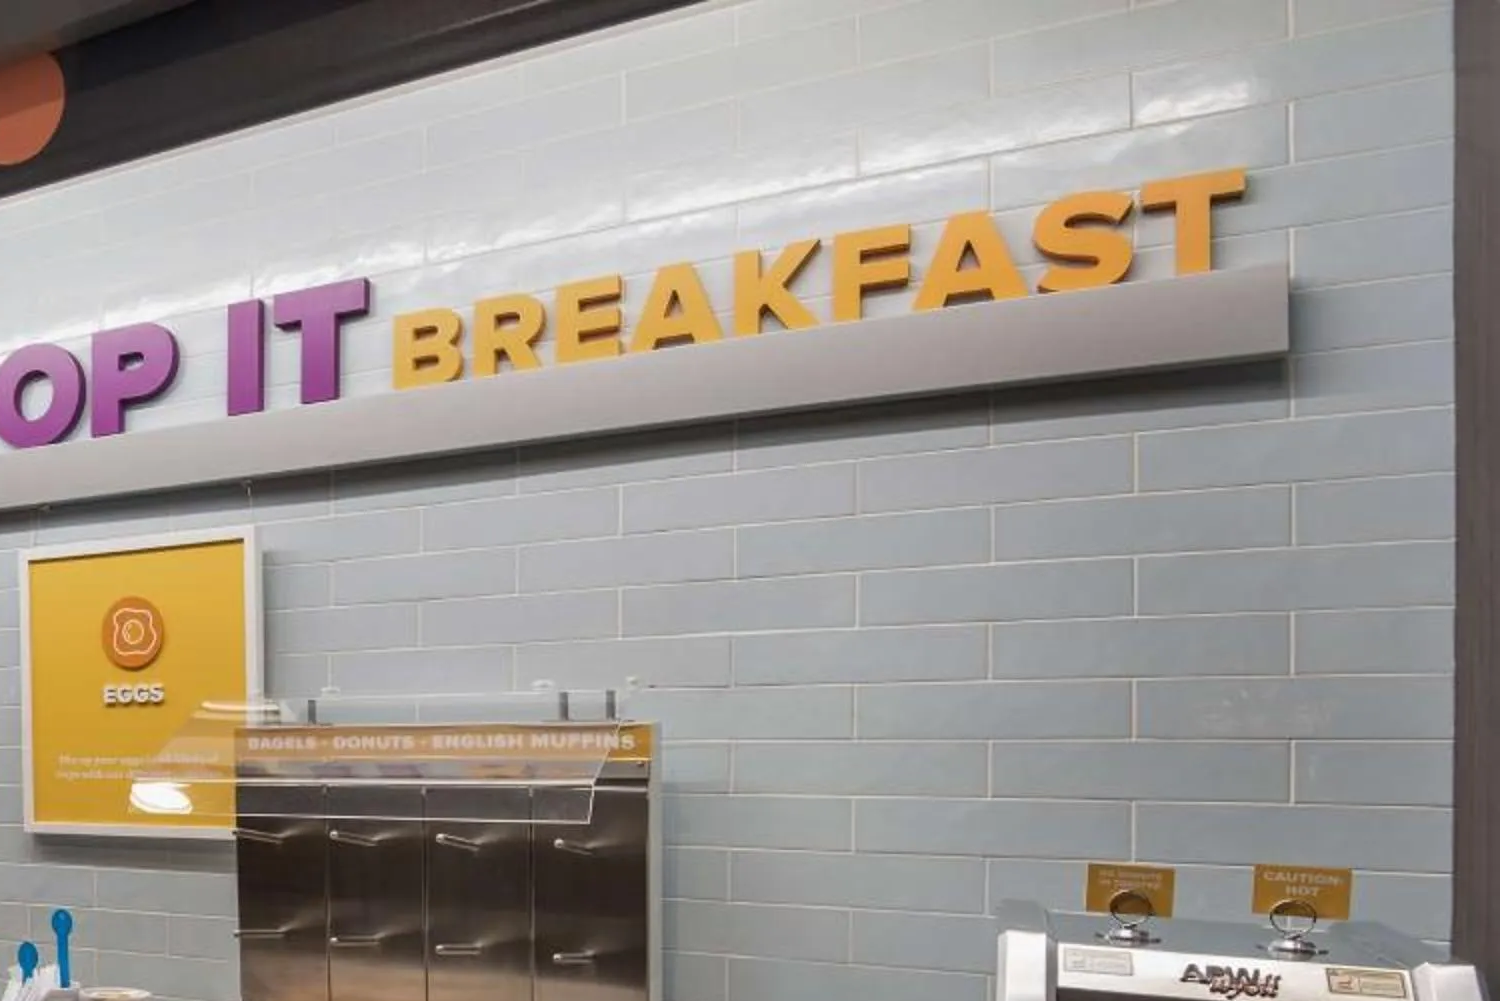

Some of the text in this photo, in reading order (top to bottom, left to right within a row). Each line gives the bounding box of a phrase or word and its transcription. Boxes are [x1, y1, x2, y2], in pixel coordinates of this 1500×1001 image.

[227, 277, 370, 416] IT
[392, 167, 1250, 390] BREAKFAST
[103, 682, 165, 705] EGGS
[248, 733, 636, 750] BAGELS DONUTS ENGLISH MUFFINS
[1285, 884, 1320, 897] HOT
